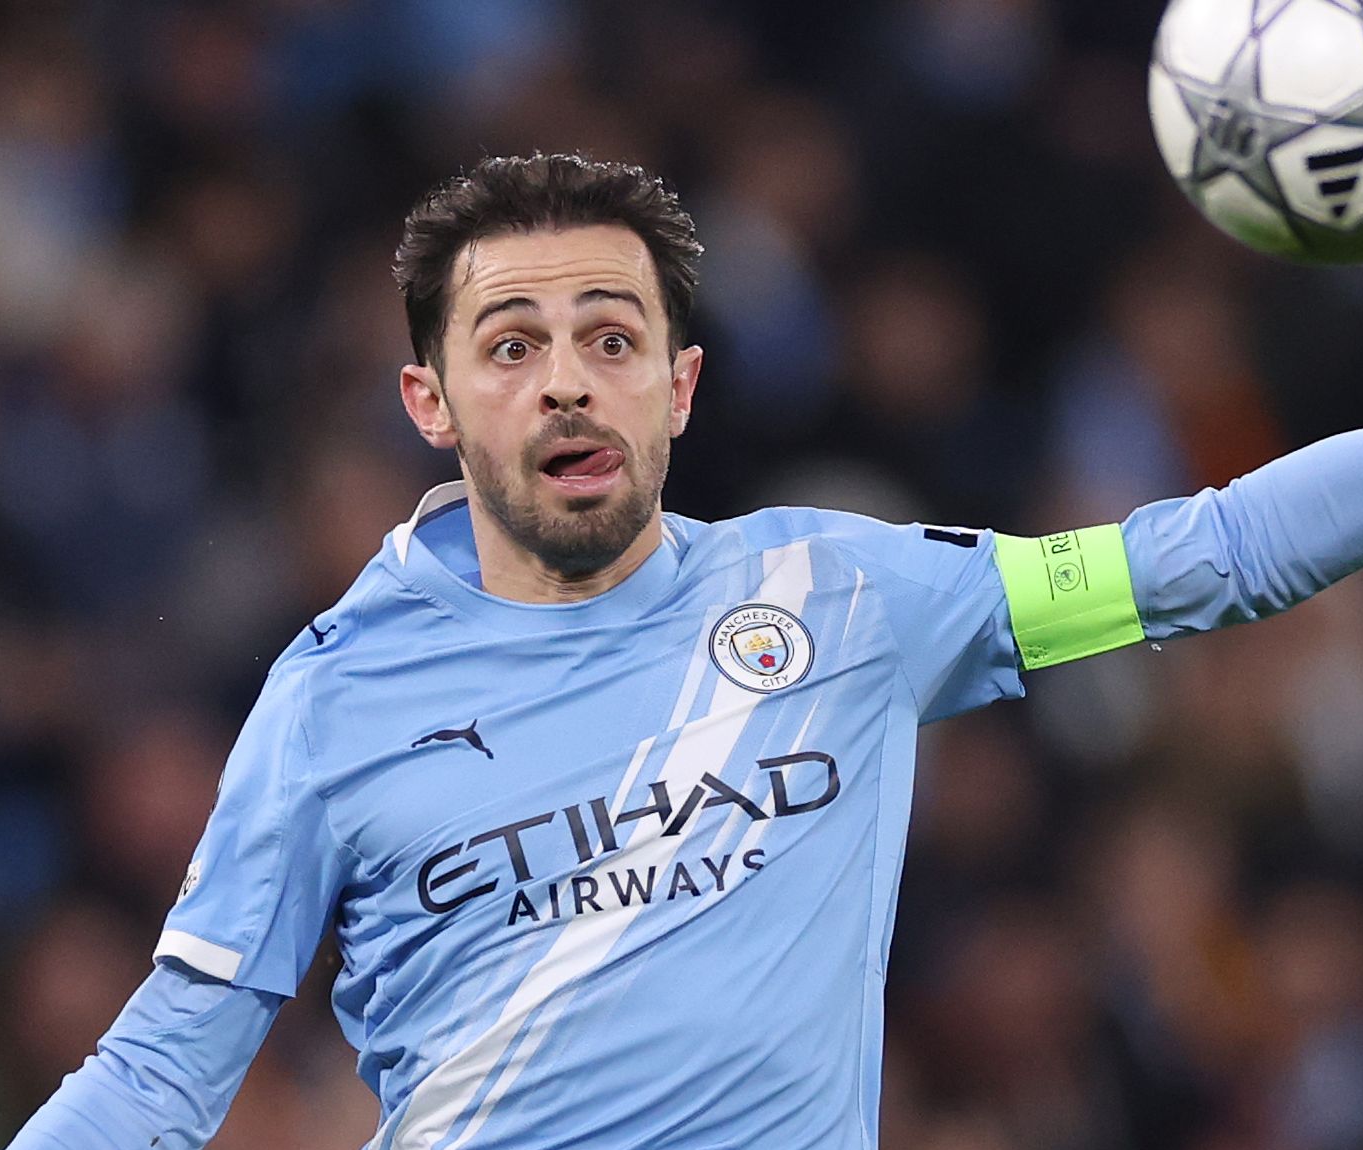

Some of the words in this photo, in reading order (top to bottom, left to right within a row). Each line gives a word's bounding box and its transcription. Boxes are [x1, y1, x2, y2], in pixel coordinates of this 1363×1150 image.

[717, 611, 794, 647] MANCHESTER
[761, 674, 790, 688] CITY
[417, 751, 841, 914] ETIHAD
[507, 848, 766, 926] AIRWAYS
